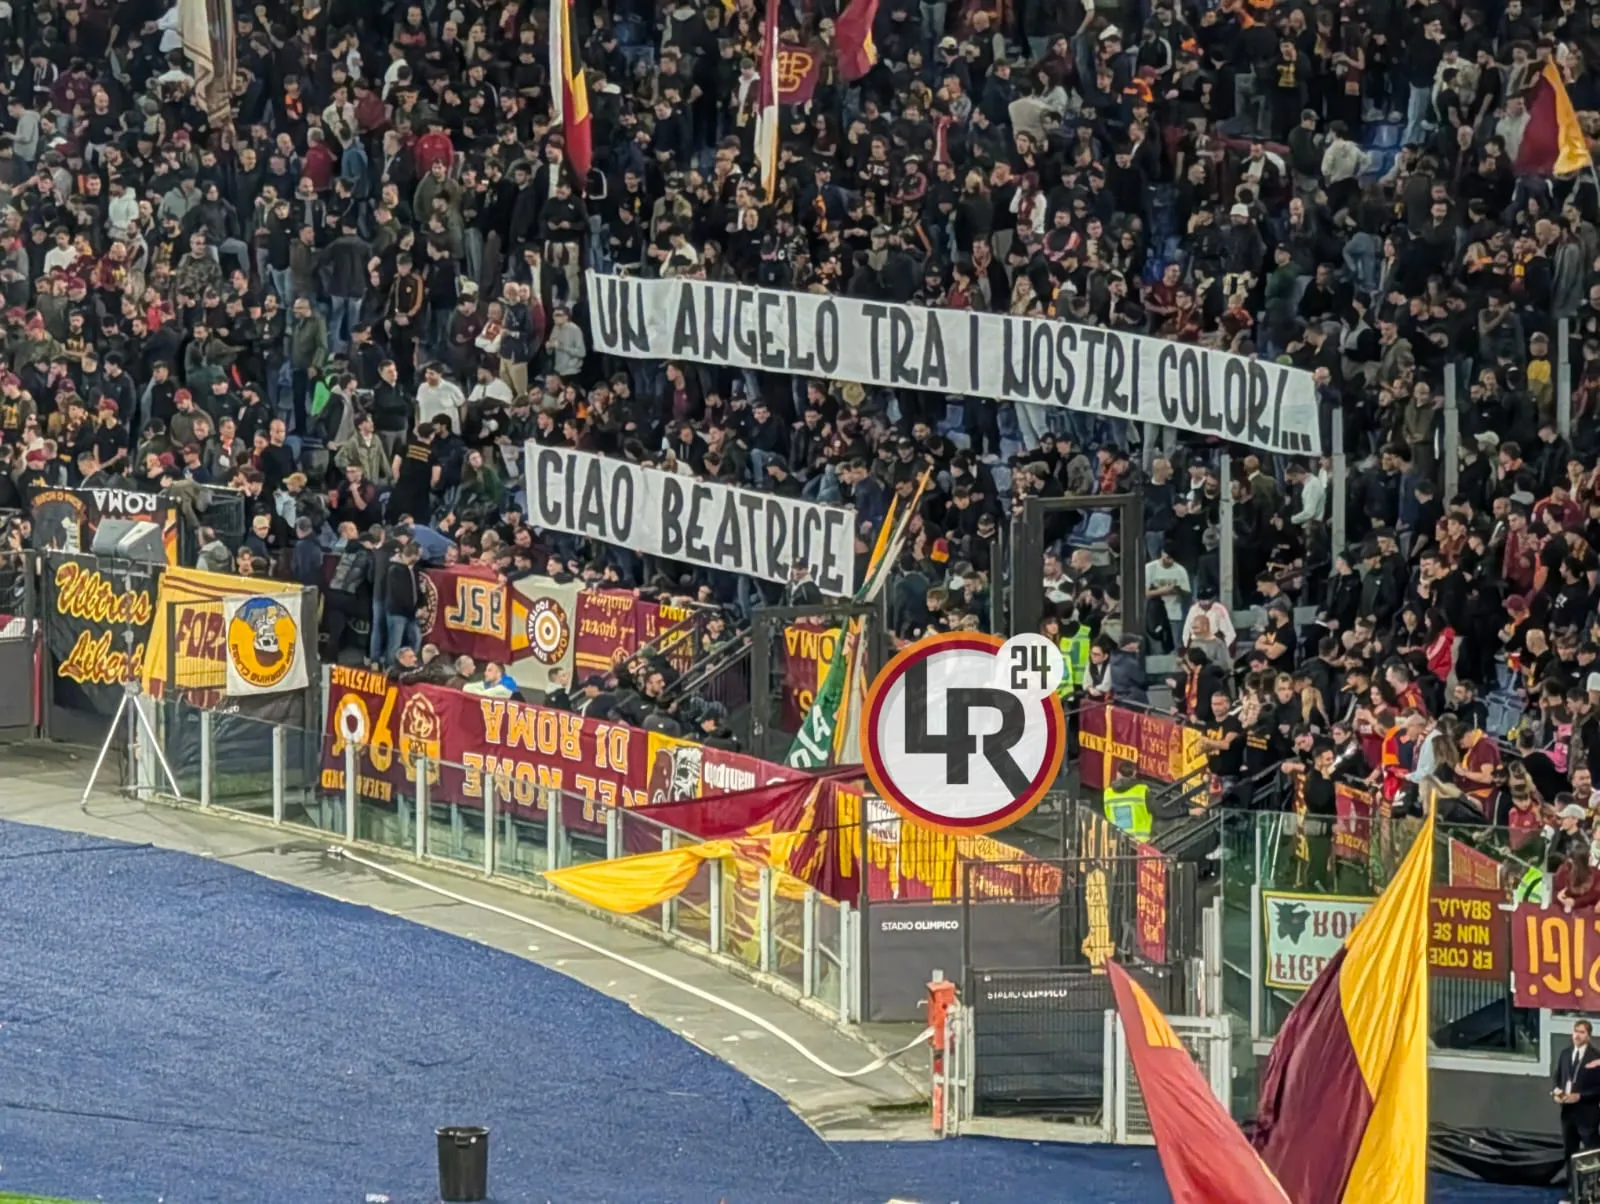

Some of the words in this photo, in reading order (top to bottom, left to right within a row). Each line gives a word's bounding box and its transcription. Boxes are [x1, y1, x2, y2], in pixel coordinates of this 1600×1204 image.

[597, 277, 650, 352] UN
[672, 282, 839, 373] ANGELO
[862, 303, 948, 387] TRA
[969, 314, 979, 391] I
[1002, 317, 1140, 415] NOSTRI
[1158, 343, 1312, 452] COLORI...
[92, 488, 157, 514] ROMA
[537, 448, 634, 543] CIAO
[662, 476, 845, 593] BEATRICE
[55, 561, 152, 625] Ultras
[550, 628, 568, 663] ROMA
[578, 617, 617, 643] giorni
[785, 626, 836, 665] OMA
[480, 698, 583, 762] ROMA
[594, 723, 631, 775] DI
[462, 751, 563, 811] NOME
[881, 921, 913, 931] STADIO
[914, 919, 959, 931] OLIMPICO
[1432, 921, 1452, 942] SE
[1457, 923, 1490, 946] NUN
[1429, 946, 1469, 968] CORE
[1472, 949, 1493, 970] ER
